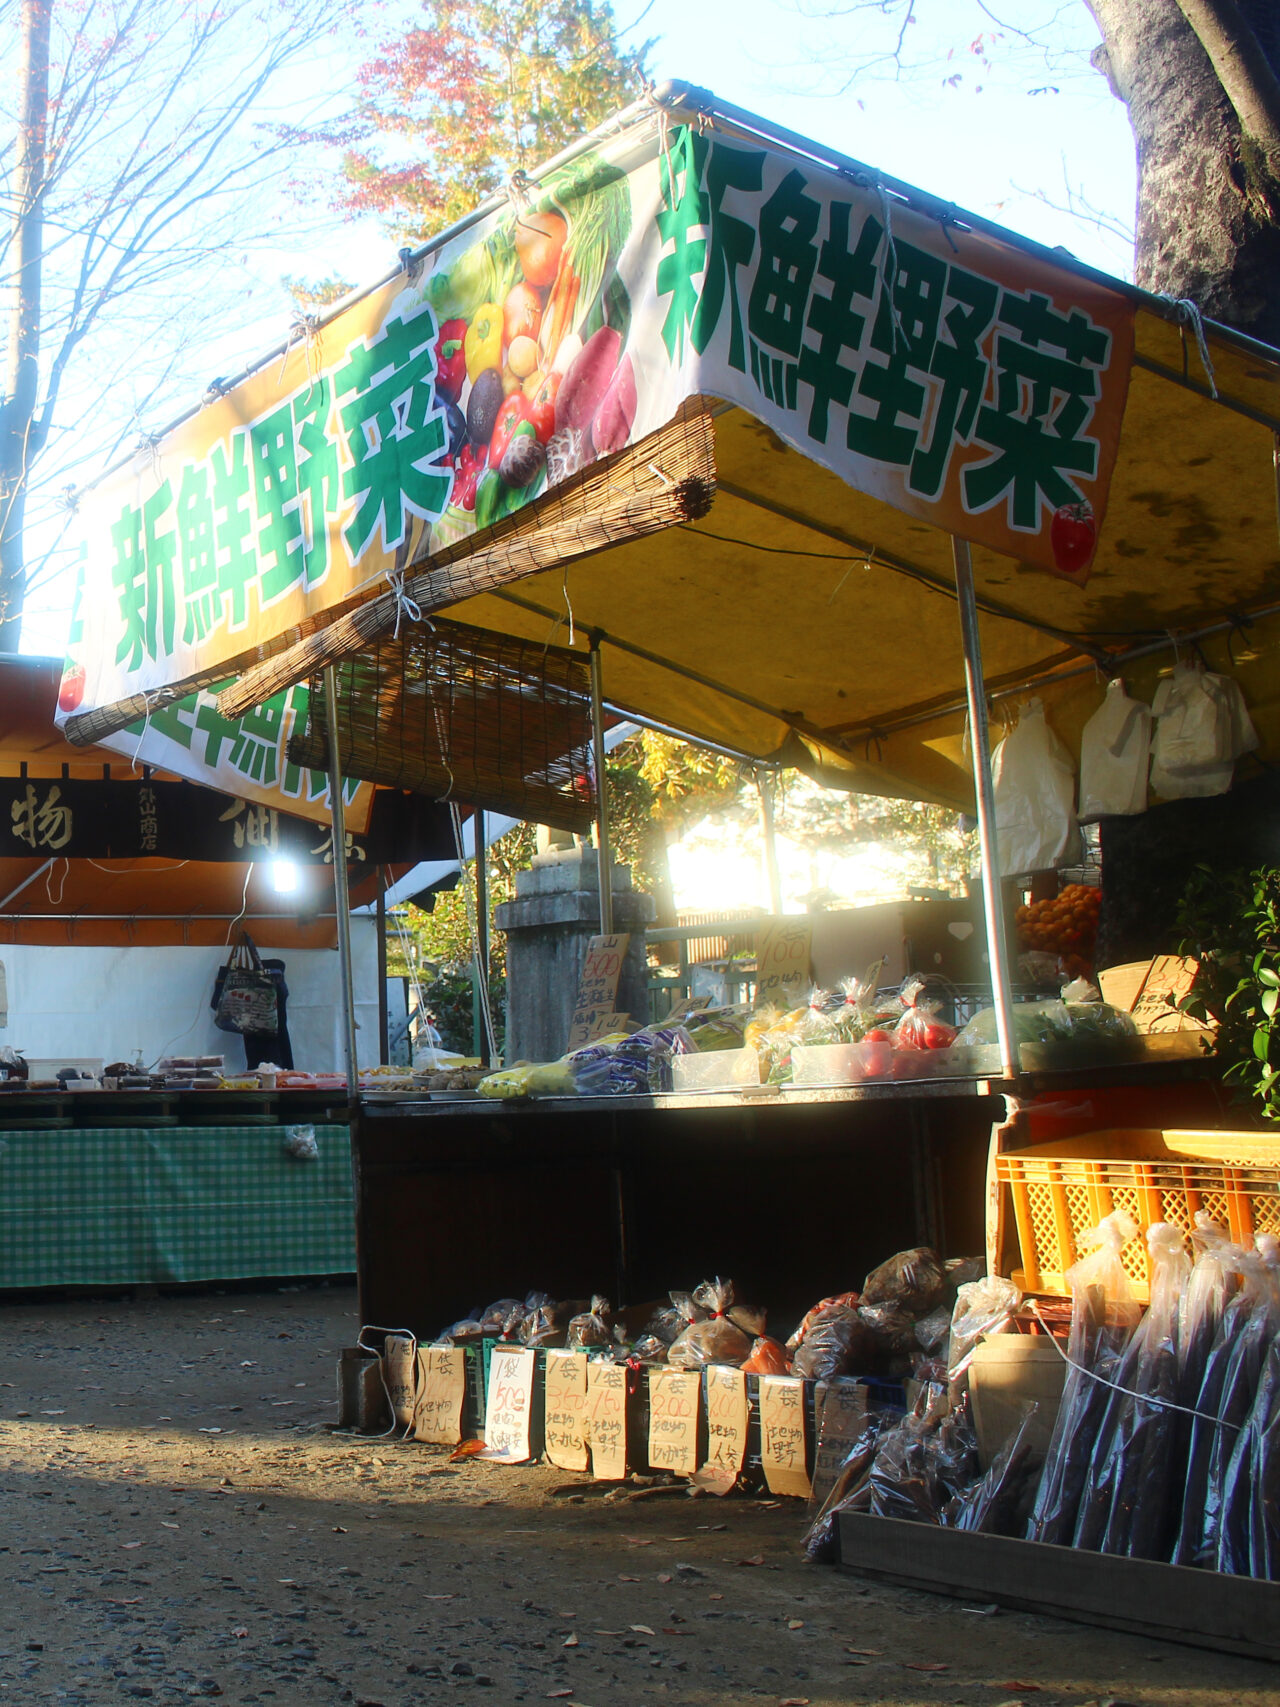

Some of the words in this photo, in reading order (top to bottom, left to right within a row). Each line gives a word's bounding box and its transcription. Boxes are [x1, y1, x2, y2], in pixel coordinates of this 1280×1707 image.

[655, 126, 1111, 530] 新鮮野菜
[111, 308, 454, 673] 新鮮野菜
[583, 953, 620, 978] 500
[760, 940, 805, 971] 100
[651, 1394, 692, 1418] 200
